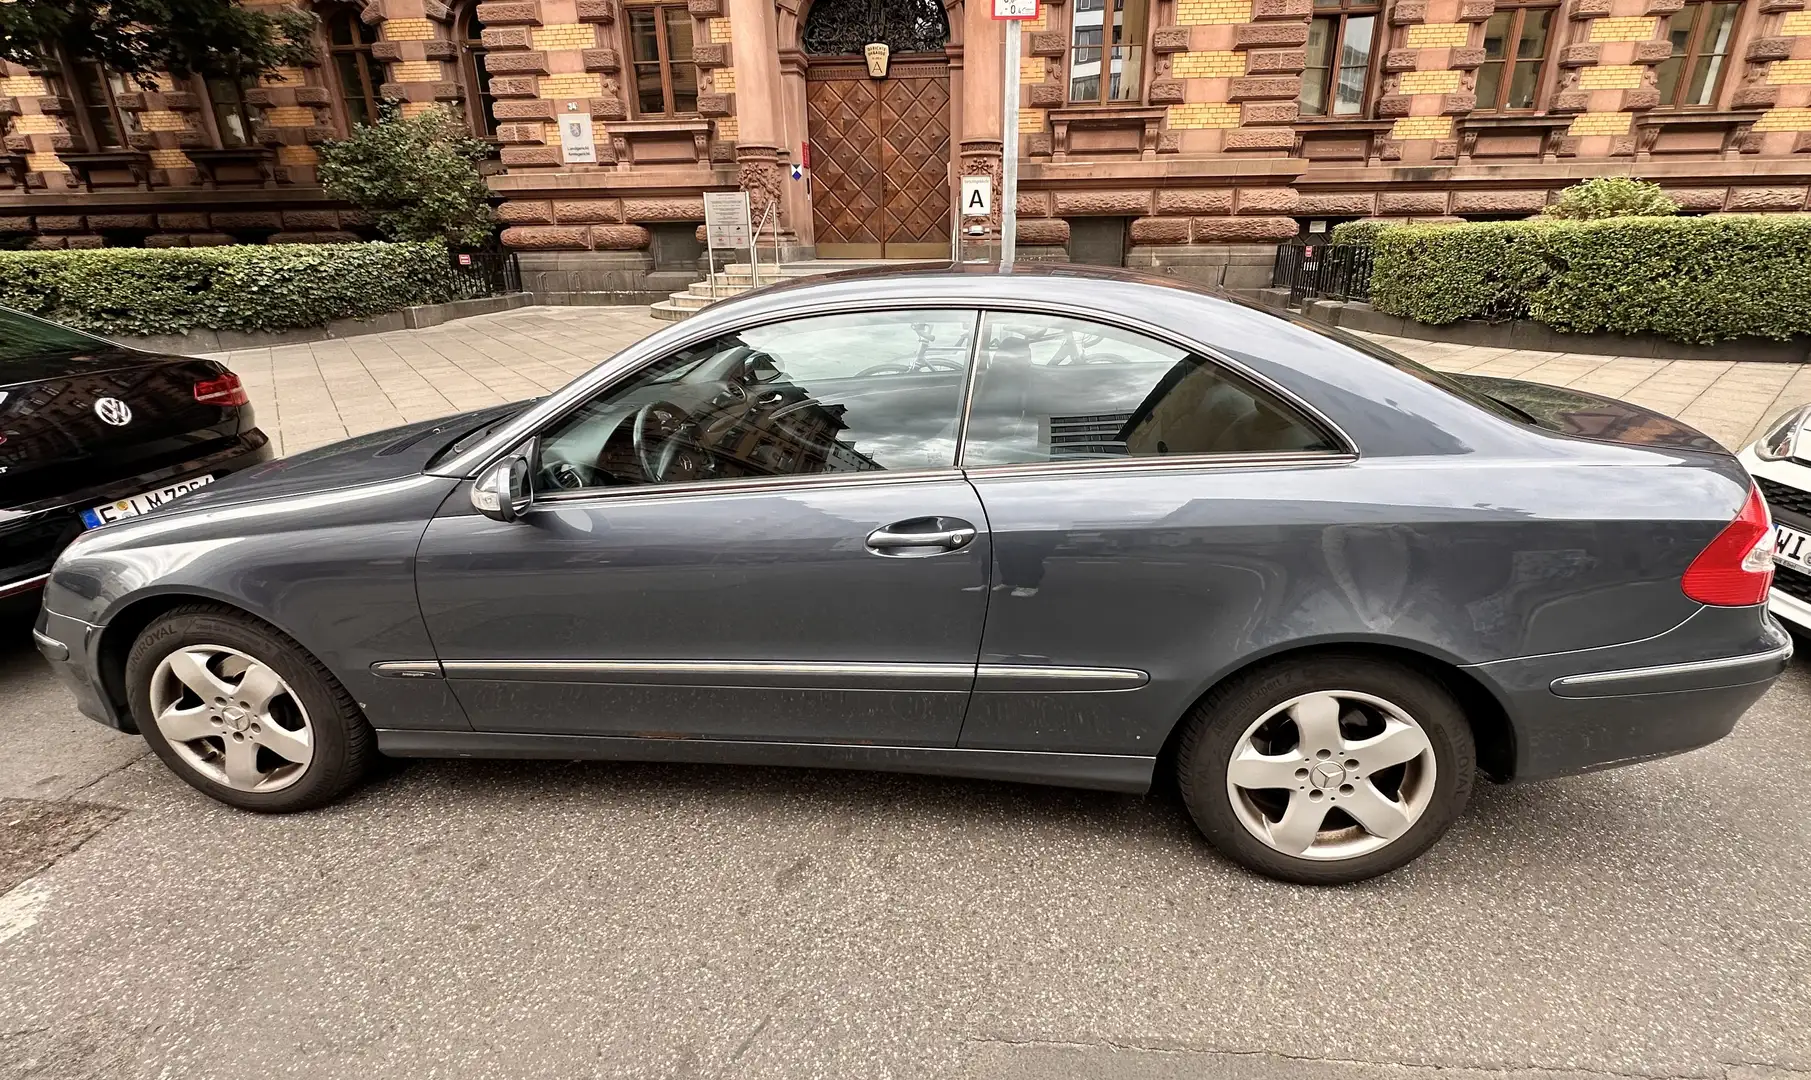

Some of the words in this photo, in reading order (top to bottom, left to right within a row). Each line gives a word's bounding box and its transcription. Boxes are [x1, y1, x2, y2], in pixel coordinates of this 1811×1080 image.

[872, 61, 883, 73] A
[969, 190, 984, 207] A
[1776, 529, 1805, 560] WI
